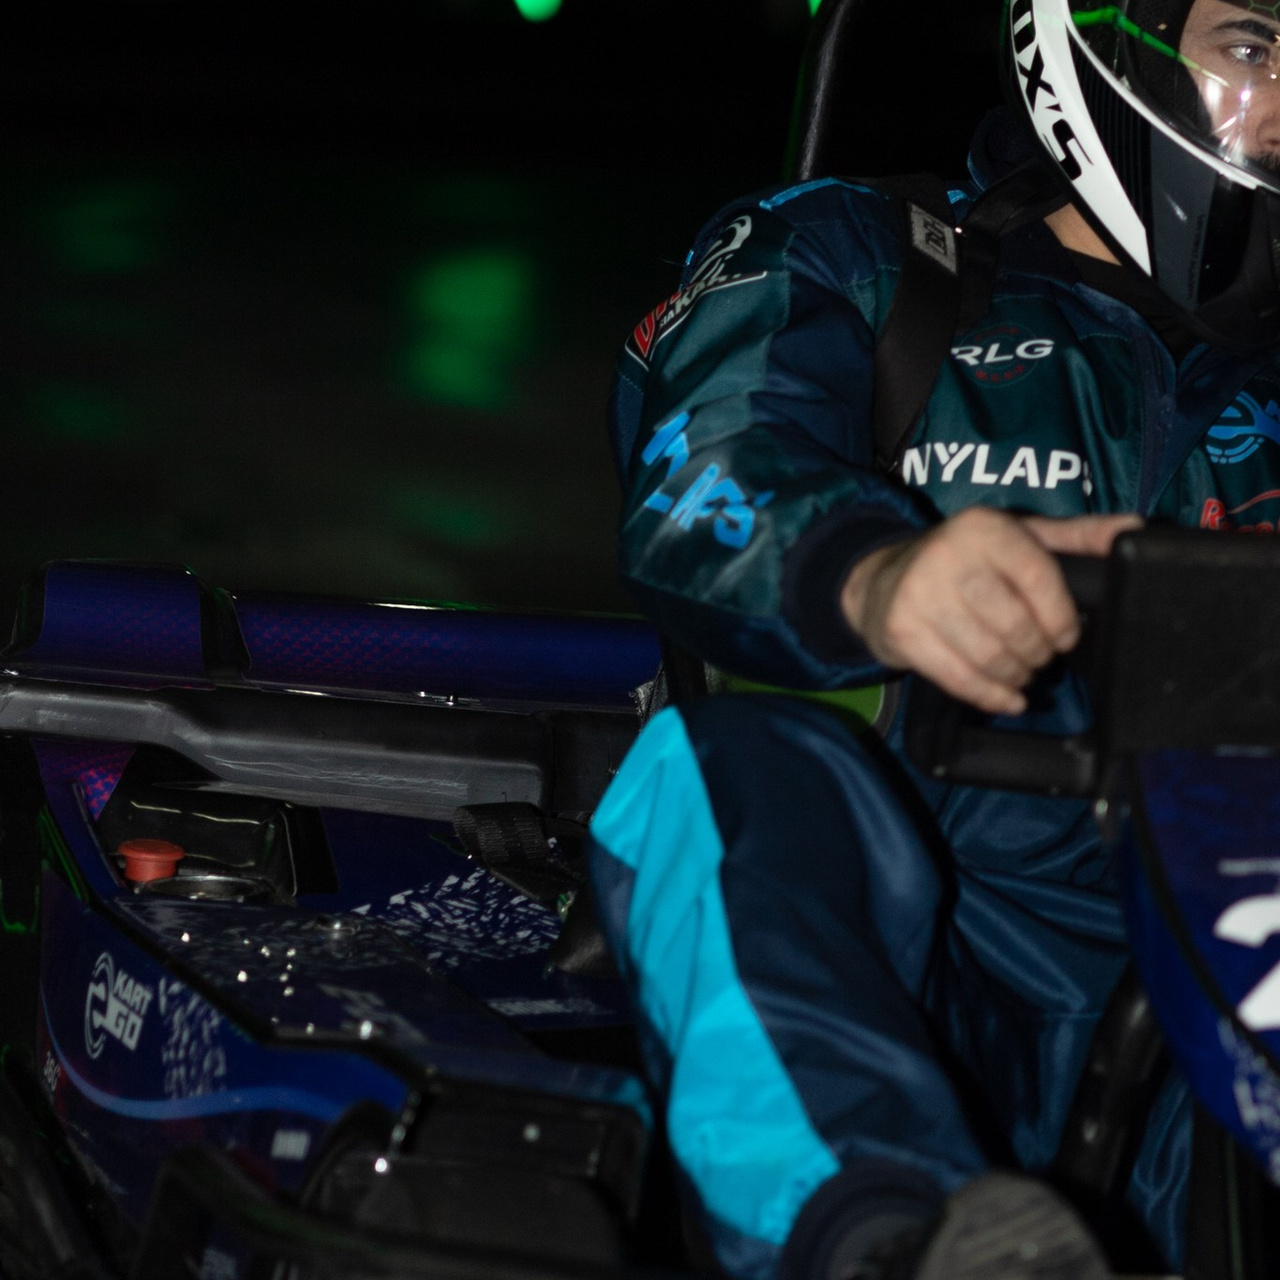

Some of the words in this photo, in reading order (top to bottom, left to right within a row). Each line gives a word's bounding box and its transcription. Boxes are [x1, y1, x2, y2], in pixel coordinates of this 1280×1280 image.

[950, 338, 1055, 367] RLG
[902, 441, 1093, 497] YLAP
[113, 969, 154, 1016] KART
